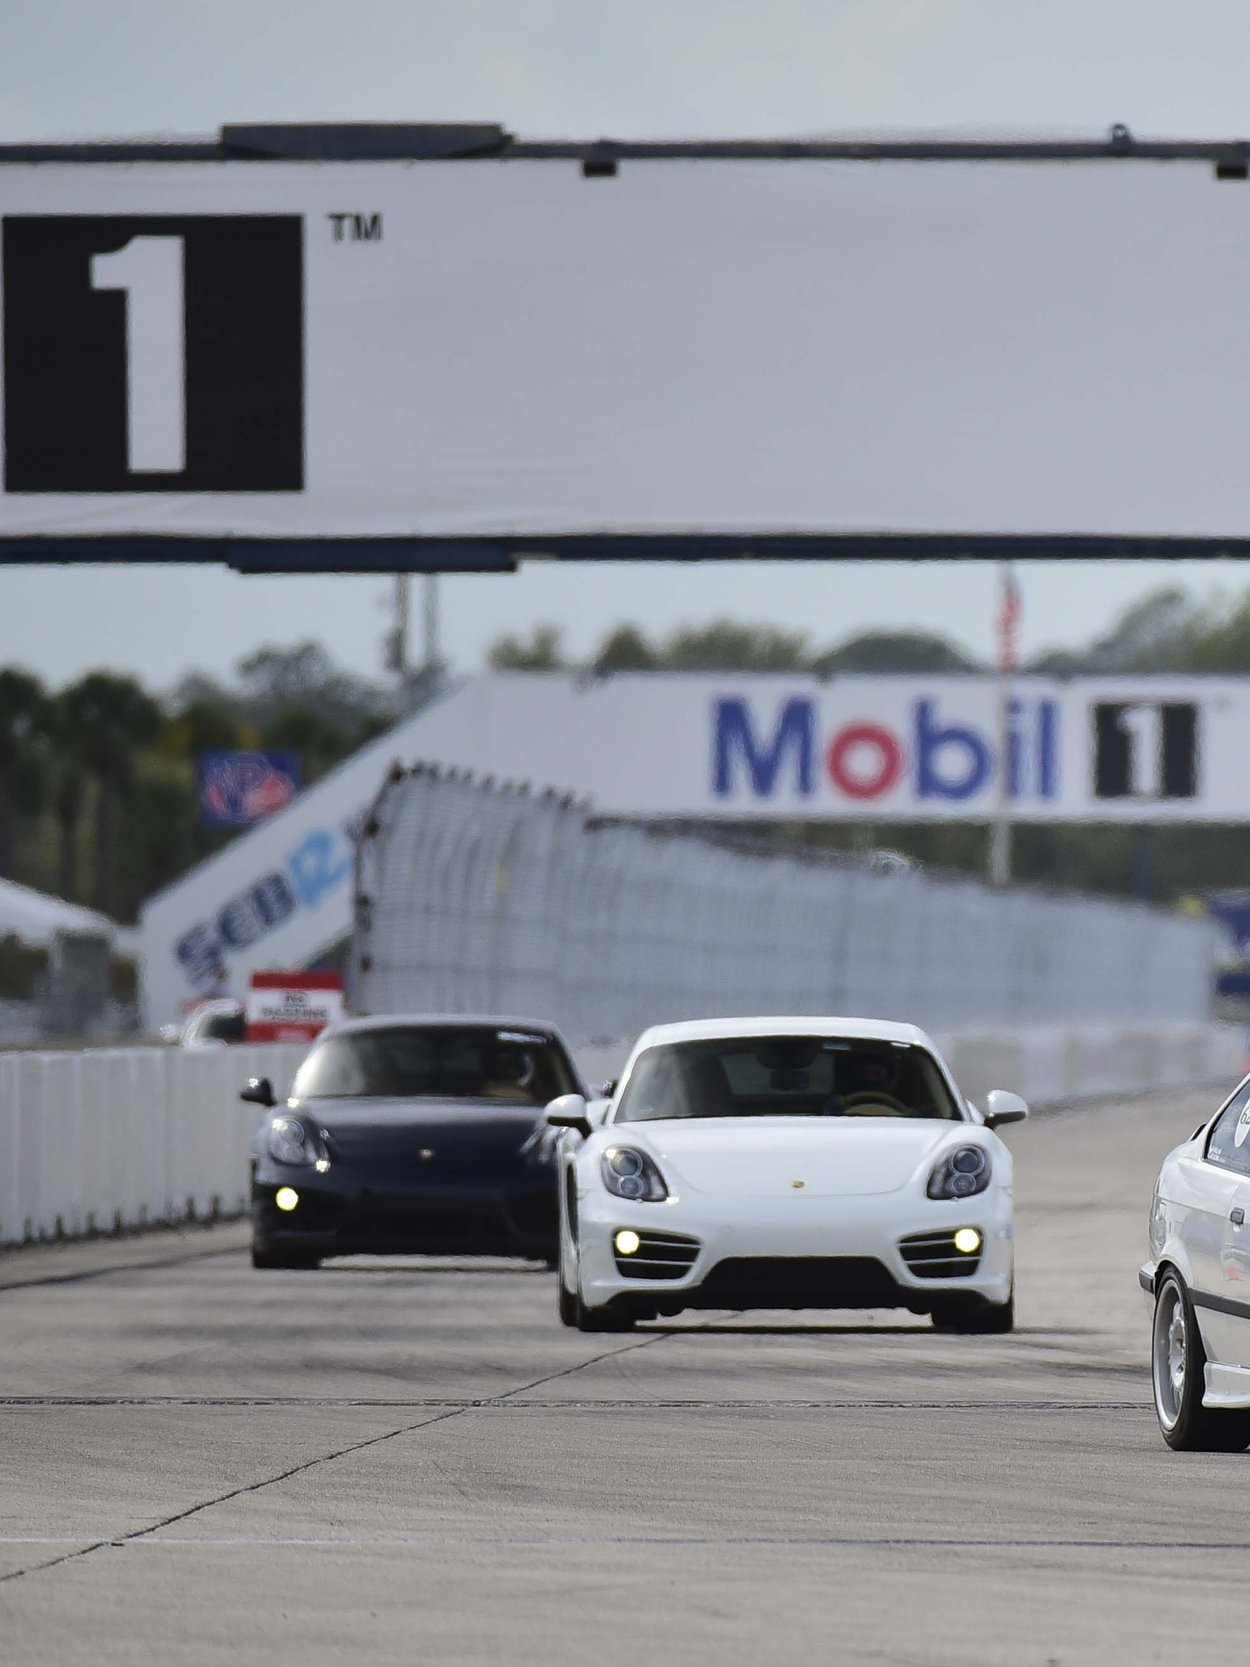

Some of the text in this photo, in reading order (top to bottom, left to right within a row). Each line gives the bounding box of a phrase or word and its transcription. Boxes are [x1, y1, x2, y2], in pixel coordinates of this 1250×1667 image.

[90, 213, 382, 474] 1 TM
[713, 697, 1164, 801] Mobil 1
